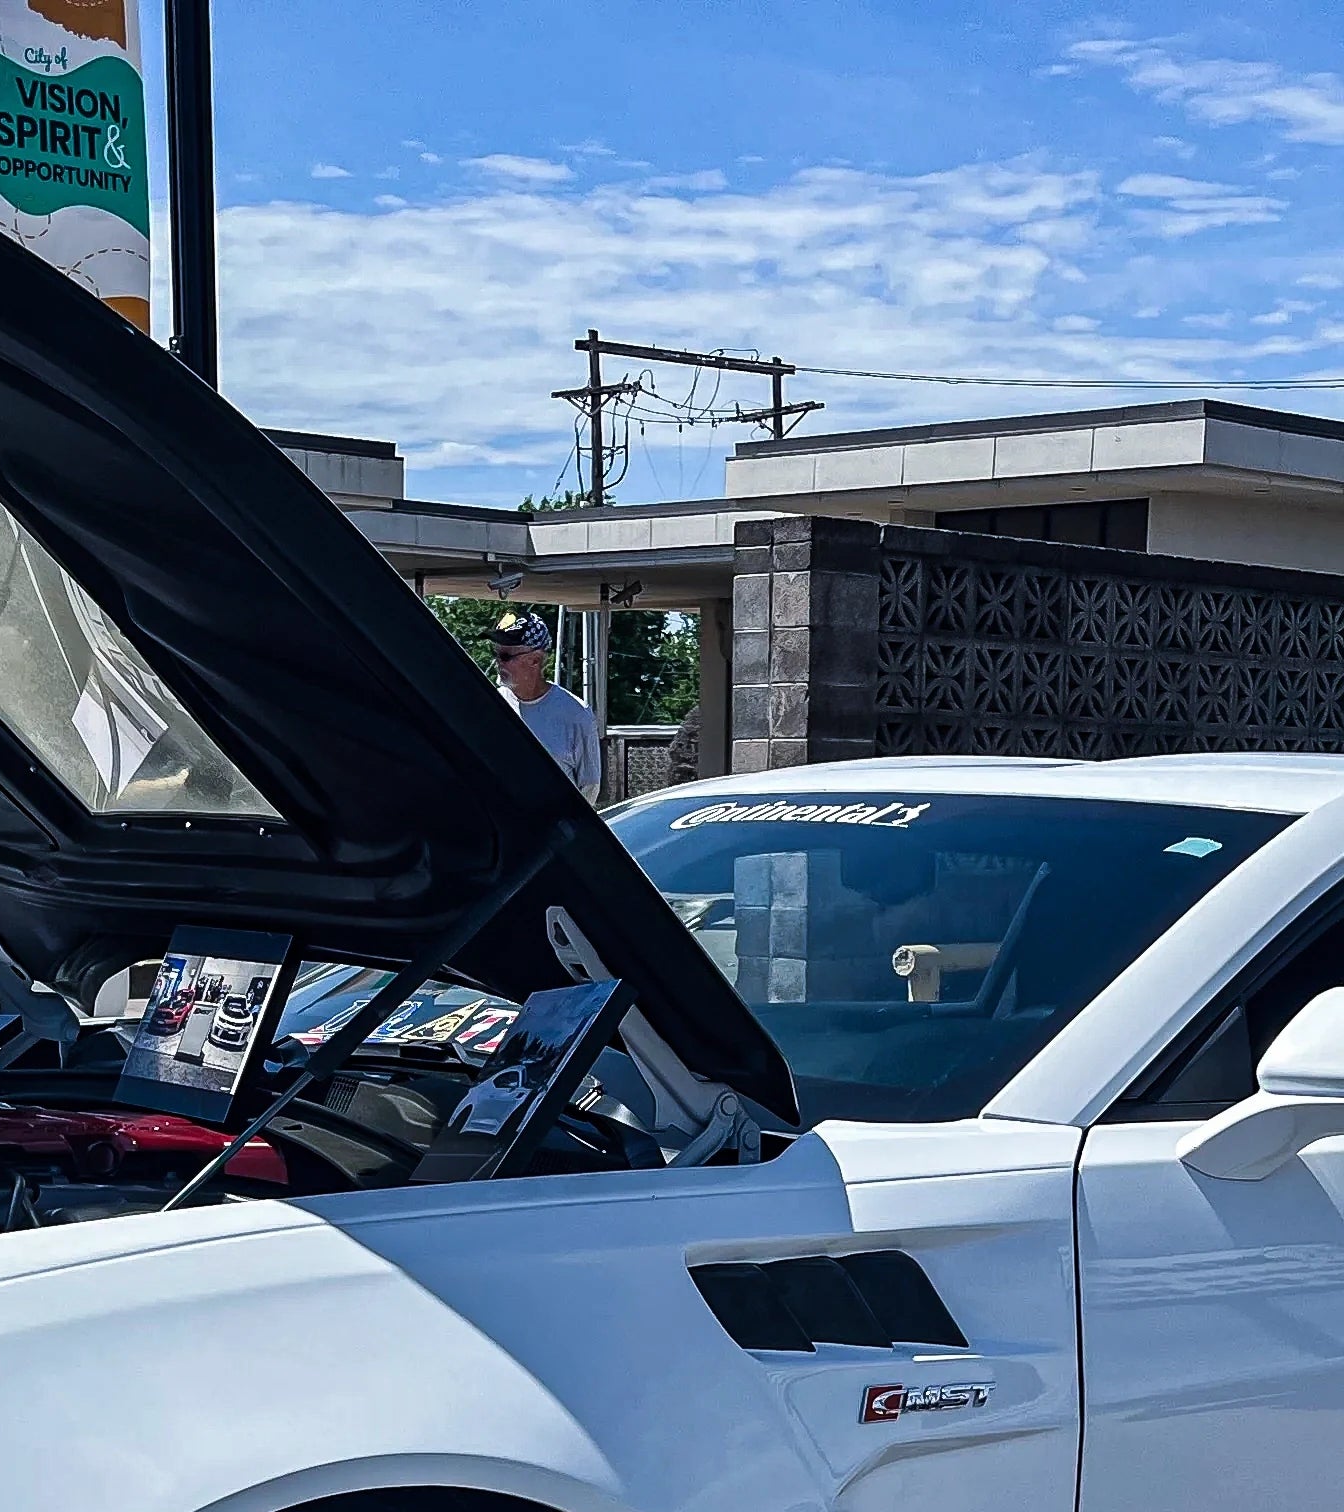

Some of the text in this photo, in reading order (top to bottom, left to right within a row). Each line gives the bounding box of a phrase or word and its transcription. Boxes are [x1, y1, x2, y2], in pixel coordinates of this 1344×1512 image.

[25, 47, 68, 71] City of
[15, 77, 128, 129] VISION,
[104, 124, 131, 169] &
[670, 801, 906, 829] Continental
